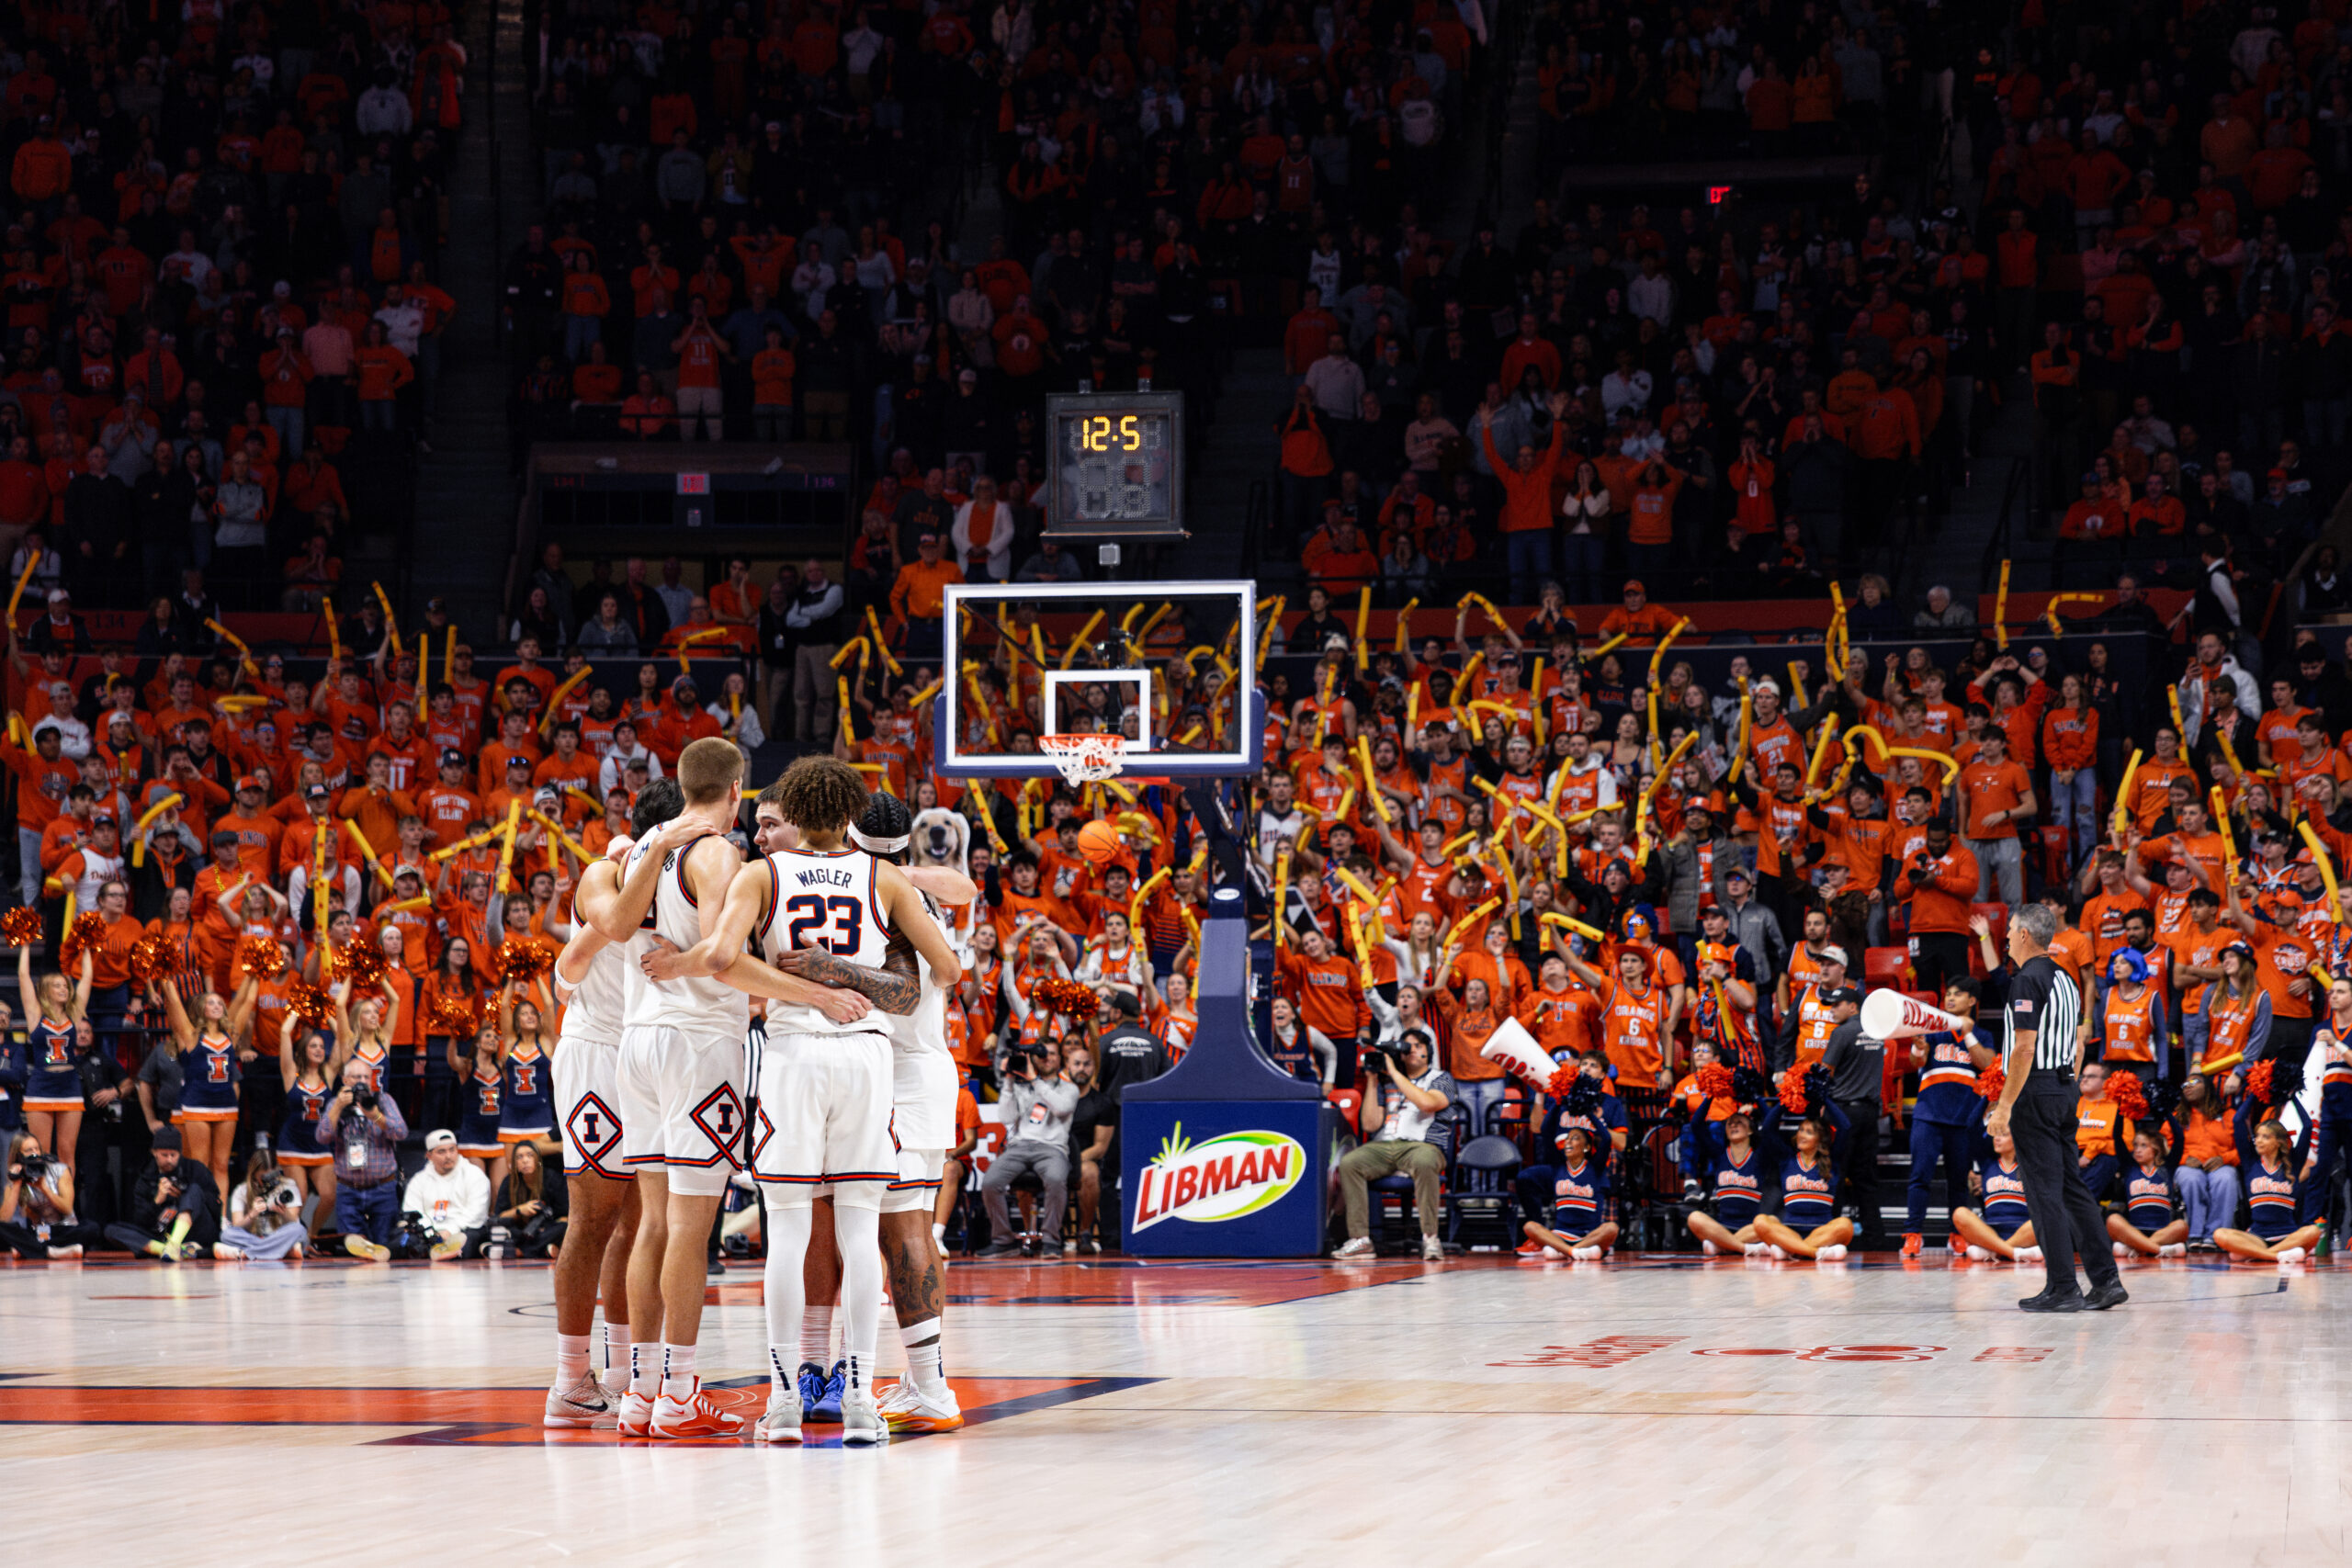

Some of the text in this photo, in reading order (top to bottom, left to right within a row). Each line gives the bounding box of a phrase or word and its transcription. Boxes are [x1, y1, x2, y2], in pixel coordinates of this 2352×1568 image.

[432, 794, 470, 812] FIGHTING
[796, 869, 853, 889] WAGLER
[786, 894, 863, 957] 23
[1614, 1005, 1656, 1022] ORANGE
[2108, 1014, 2143, 1028] ORANGE
[1629, 1019, 1641, 1036] 6
[1814, 1021, 1826, 1039] 6
[2119, 1025, 2129, 1040] 6
[2220, 1021, 2230, 1036] 6
[47, 1035, 69, 1063] I
[1618, 1034, 1649, 1048] KRUSH
[207, 1054, 229, 1083] I
[514, 1065, 536, 1095] I
[302, 1095, 323, 1121] I
[480, 1087, 500, 1115] I
[718, 1102, 733, 1134] I
[583, 1112, 600, 1144] I
[1136, 1145, 1291, 1225] LIBMAN
[1555, 1179, 1594, 1198] Illinois
[1718, 1170, 1758, 1189] Illinois
[1785, 1174, 1828, 1192] Illinois
[2129, 1179, 2169, 1196] Illinois
[2250, 1176, 2293, 1195] Illinois
